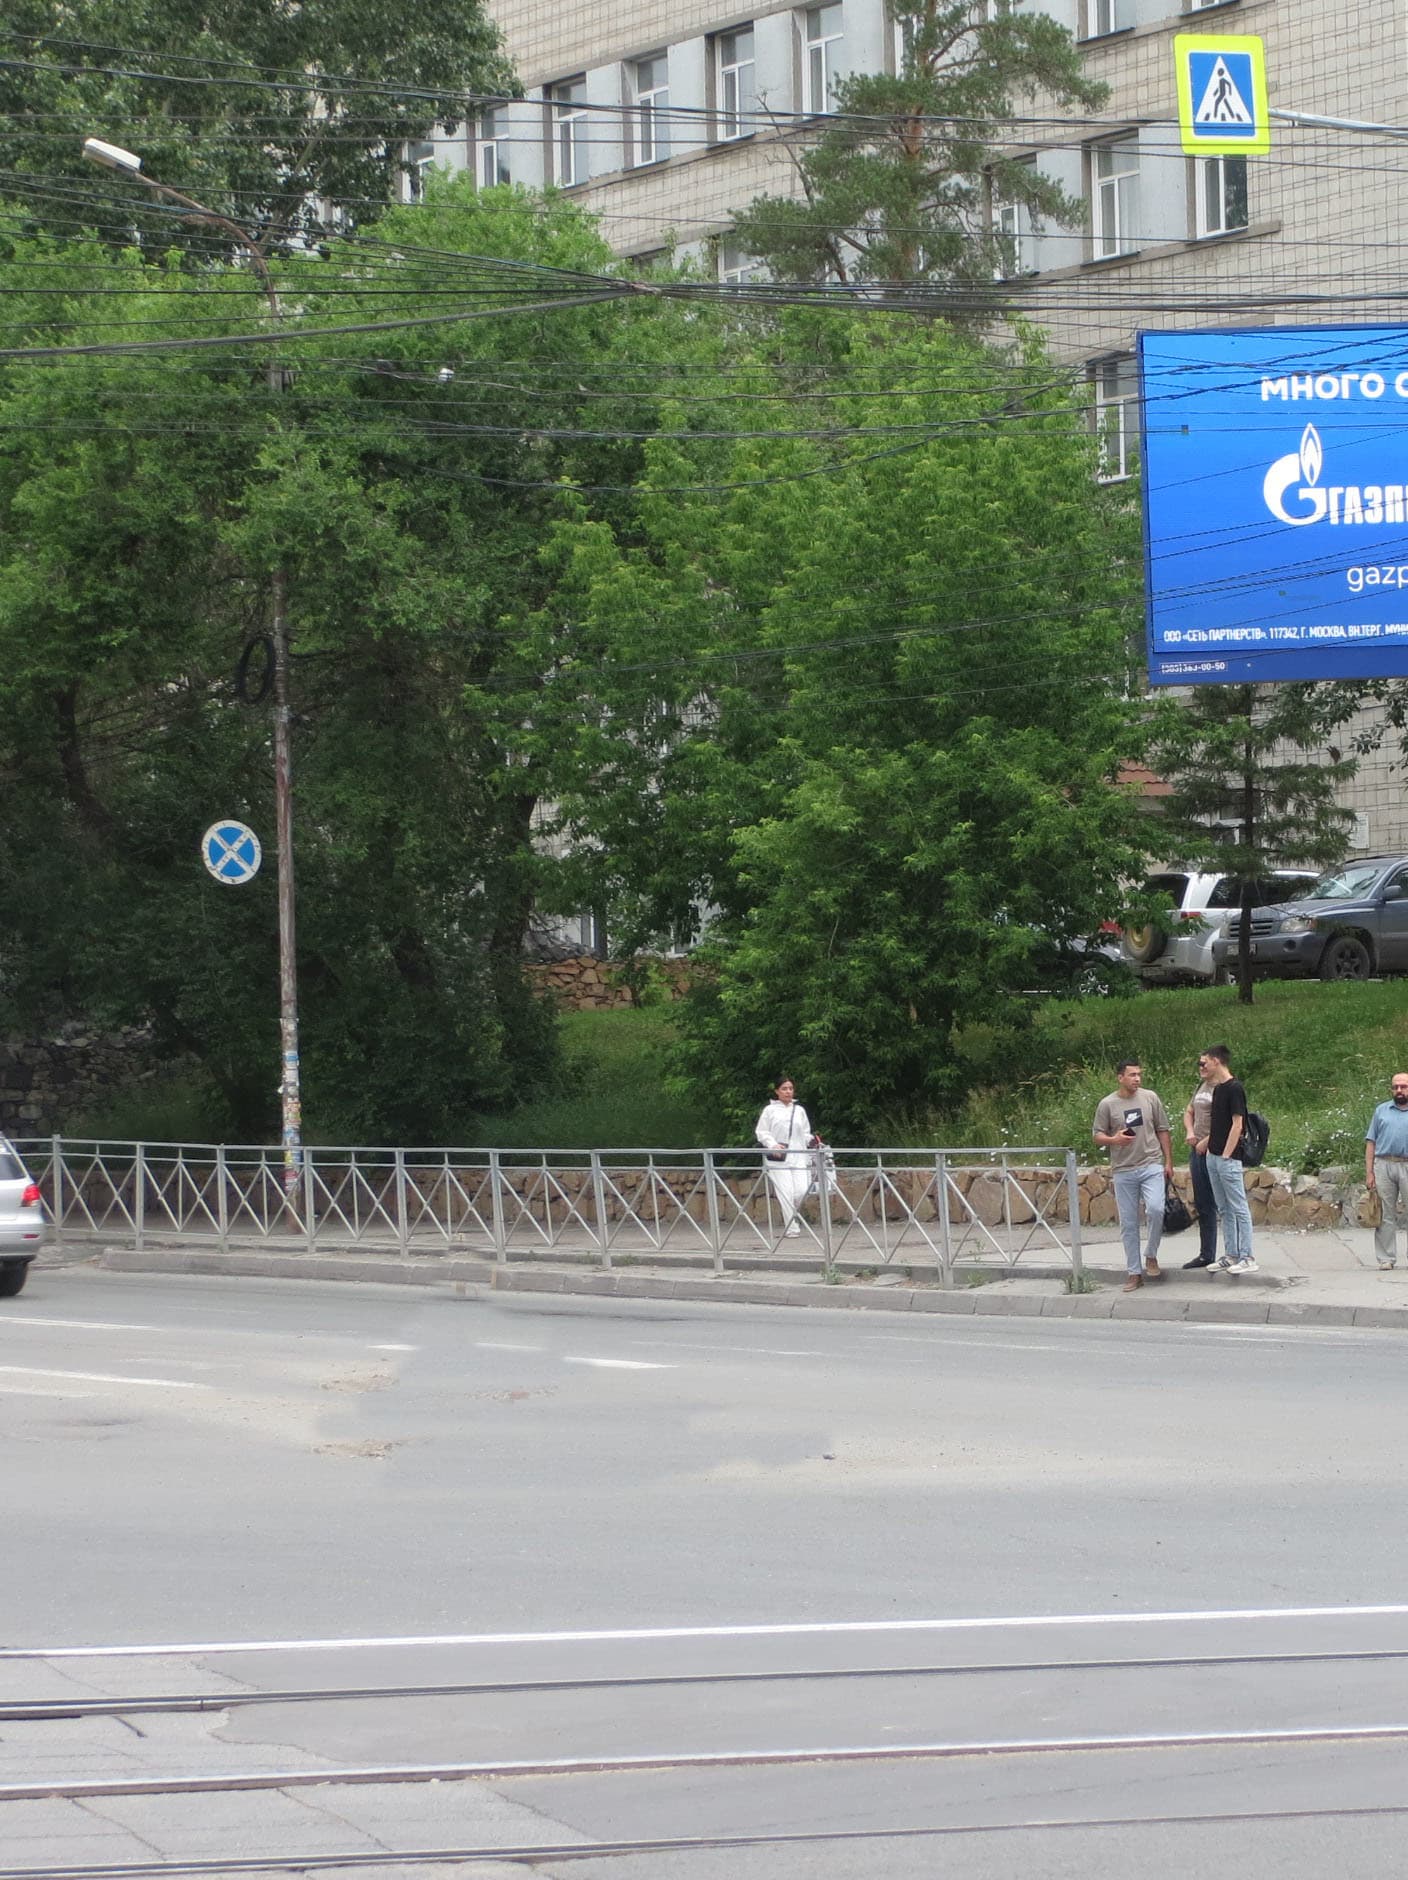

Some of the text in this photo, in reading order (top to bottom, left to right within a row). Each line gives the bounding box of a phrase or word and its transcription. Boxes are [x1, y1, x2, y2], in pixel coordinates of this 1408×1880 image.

[1261, 373, 1385, 401] МНОГО
[1163, 630, 1182, 642] ООО
[1269, 627, 1299, 641] 117342,
[1309, 625, 1347, 640] МОСКВА,
